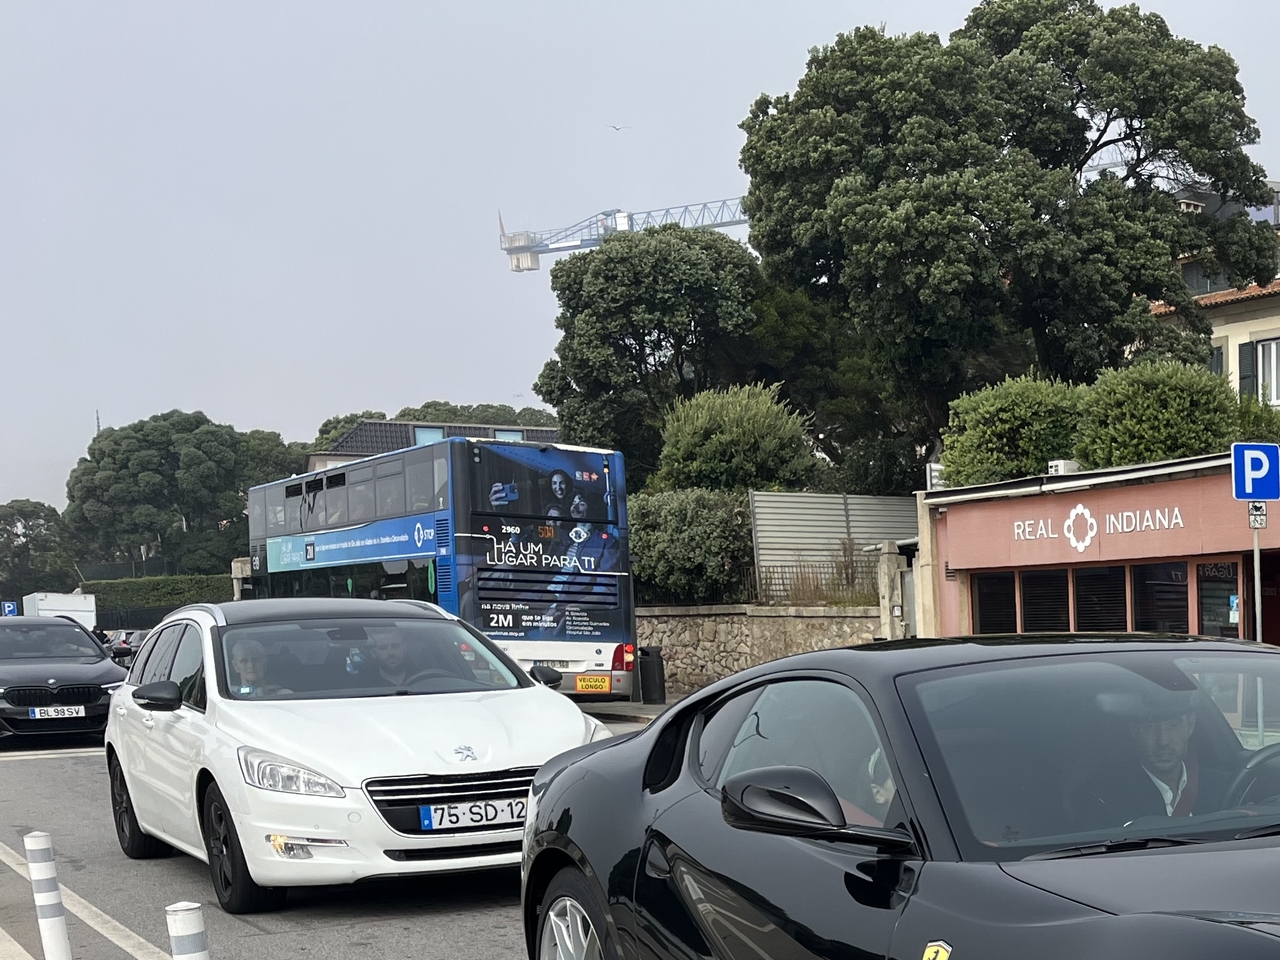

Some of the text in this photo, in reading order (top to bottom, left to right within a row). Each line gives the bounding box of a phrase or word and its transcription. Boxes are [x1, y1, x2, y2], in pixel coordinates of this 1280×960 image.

[1244, 450, 1270, 493] P
[501, 525, 520, 534] 2960
[1014, 507, 1184, 541] REAL INDIANA
[495, 537, 543, 555] HÁ UM
[486, 552, 595, 569] LUGAR PARA TI
[5, 603, 13, 614] P
[489, 613, 513, 627] 2M
[39, 709, 53, 717] BL
[66, 707, 80, 716] SV
